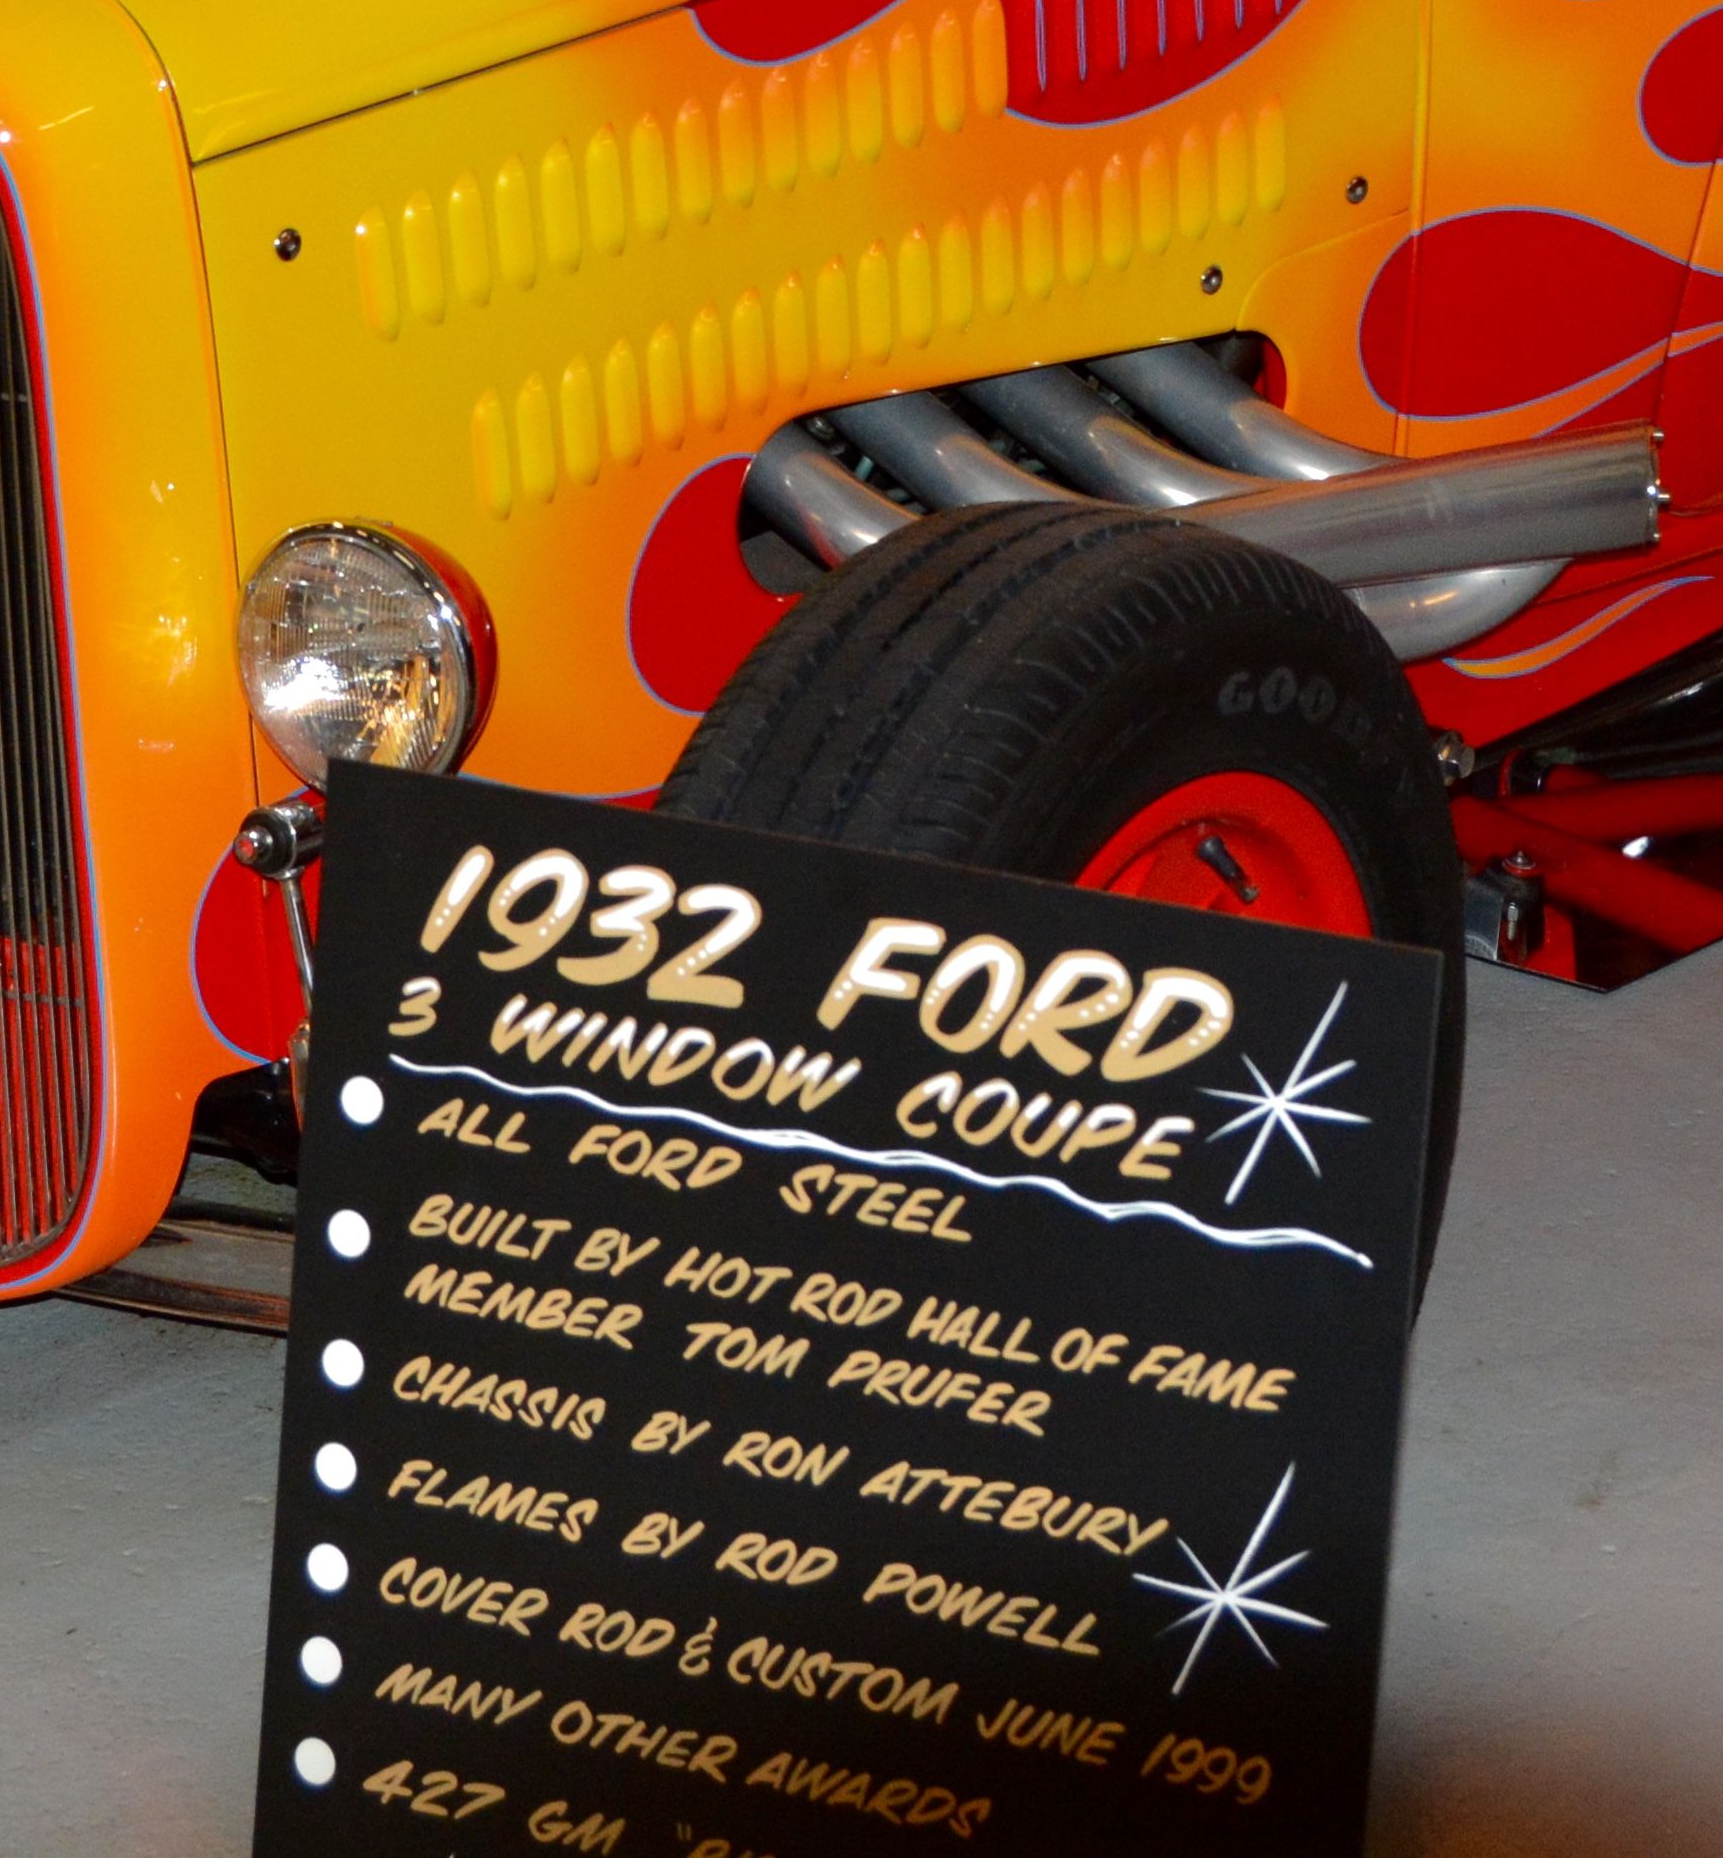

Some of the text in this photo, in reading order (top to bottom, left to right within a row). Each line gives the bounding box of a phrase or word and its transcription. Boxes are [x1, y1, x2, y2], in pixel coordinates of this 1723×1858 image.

[420, 844, 1235, 1082] 1932 FORD
[388, 976, 1195, 1180] 3 WINDOW COUPE
[417, 1097, 972, 1242] ALL FORD STEEL
[404, 1263, 1052, 1437] MEMBER TOM PRUFER
[408, 1193, 1296, 1412] BUILT BY HOT ROD HALL OF FAME
[393, 1355, 1169, 1556] CHASSIS BY RON ATTEBURY
[387, 1459, 1099, 1655] FLAMES BY ROD POWELL
[375, 1663, 991, 1836] MANY OTHER AWARDS
[379, 1557, 1271, 1802] COVER ROD & CUSTOM JUNE 1999
[363, 1760, 505, 1819] 427
[529, 1801, 625, 1853] GM
